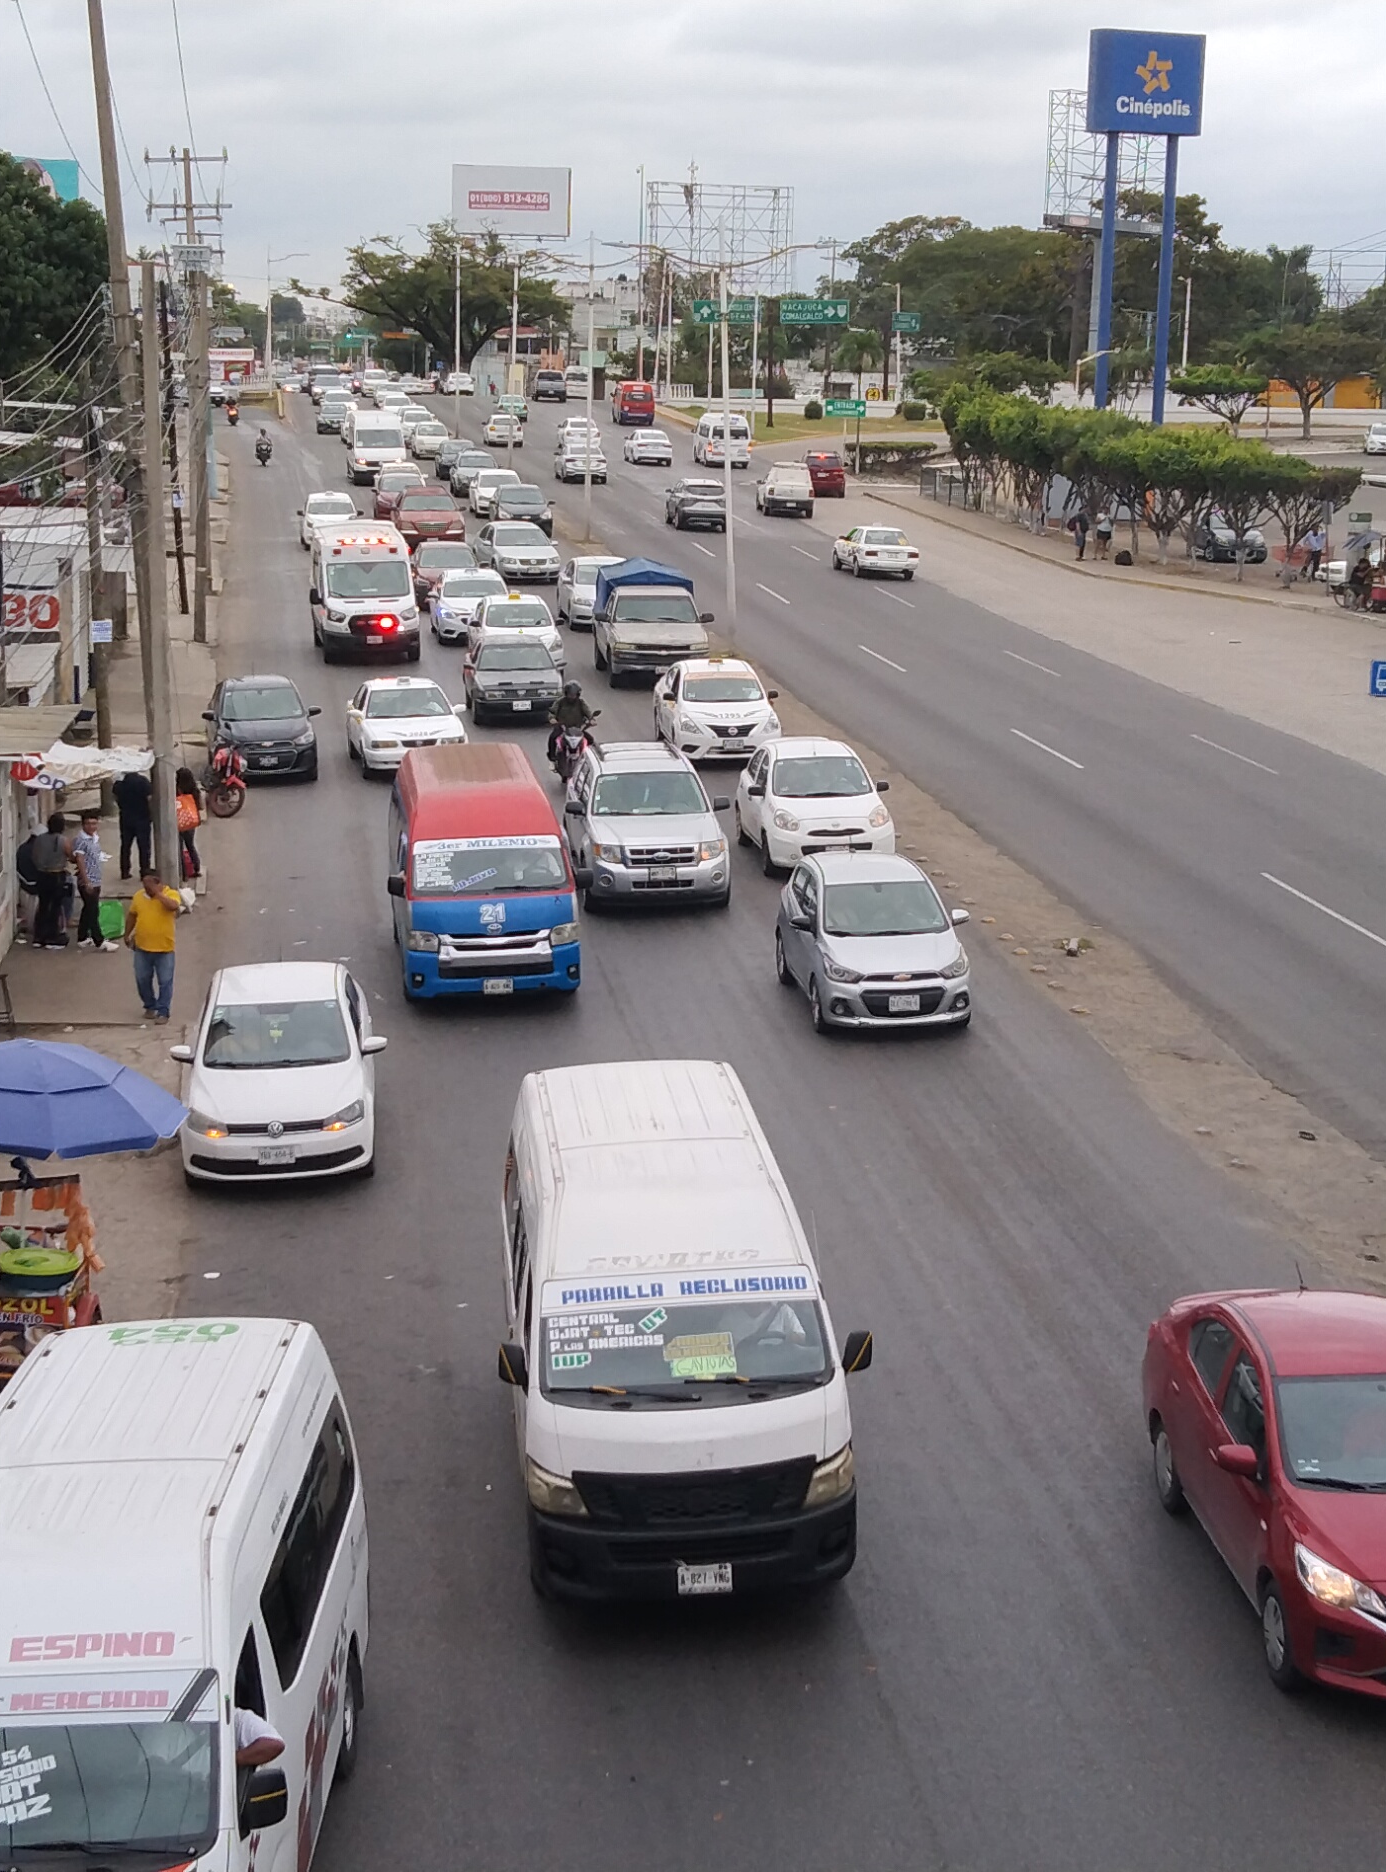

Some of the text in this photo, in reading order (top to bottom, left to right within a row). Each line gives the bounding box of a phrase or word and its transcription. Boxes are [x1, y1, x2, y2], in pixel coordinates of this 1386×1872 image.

[1116, 96, 1190, 118] Cinépolis
[466, 837, 538, 849] MILENIO
[480, 903, 506, 923] 21
[561, 1276, 808, 1305] PARRILLA RECLUSORIO
[548, 1313, 619, 1328] CENTRAL
[640, 1307, 667, 1332] UT
[549, 1324, 635, 1340] UJAT TEC
[588, 1334, 664, 1350] AMERICAS
[9, 1631, 176, 1663] ESPINO
[9, 1689, 169, 1711] MERCADO
[1, 1744, 33, 1767] 54
